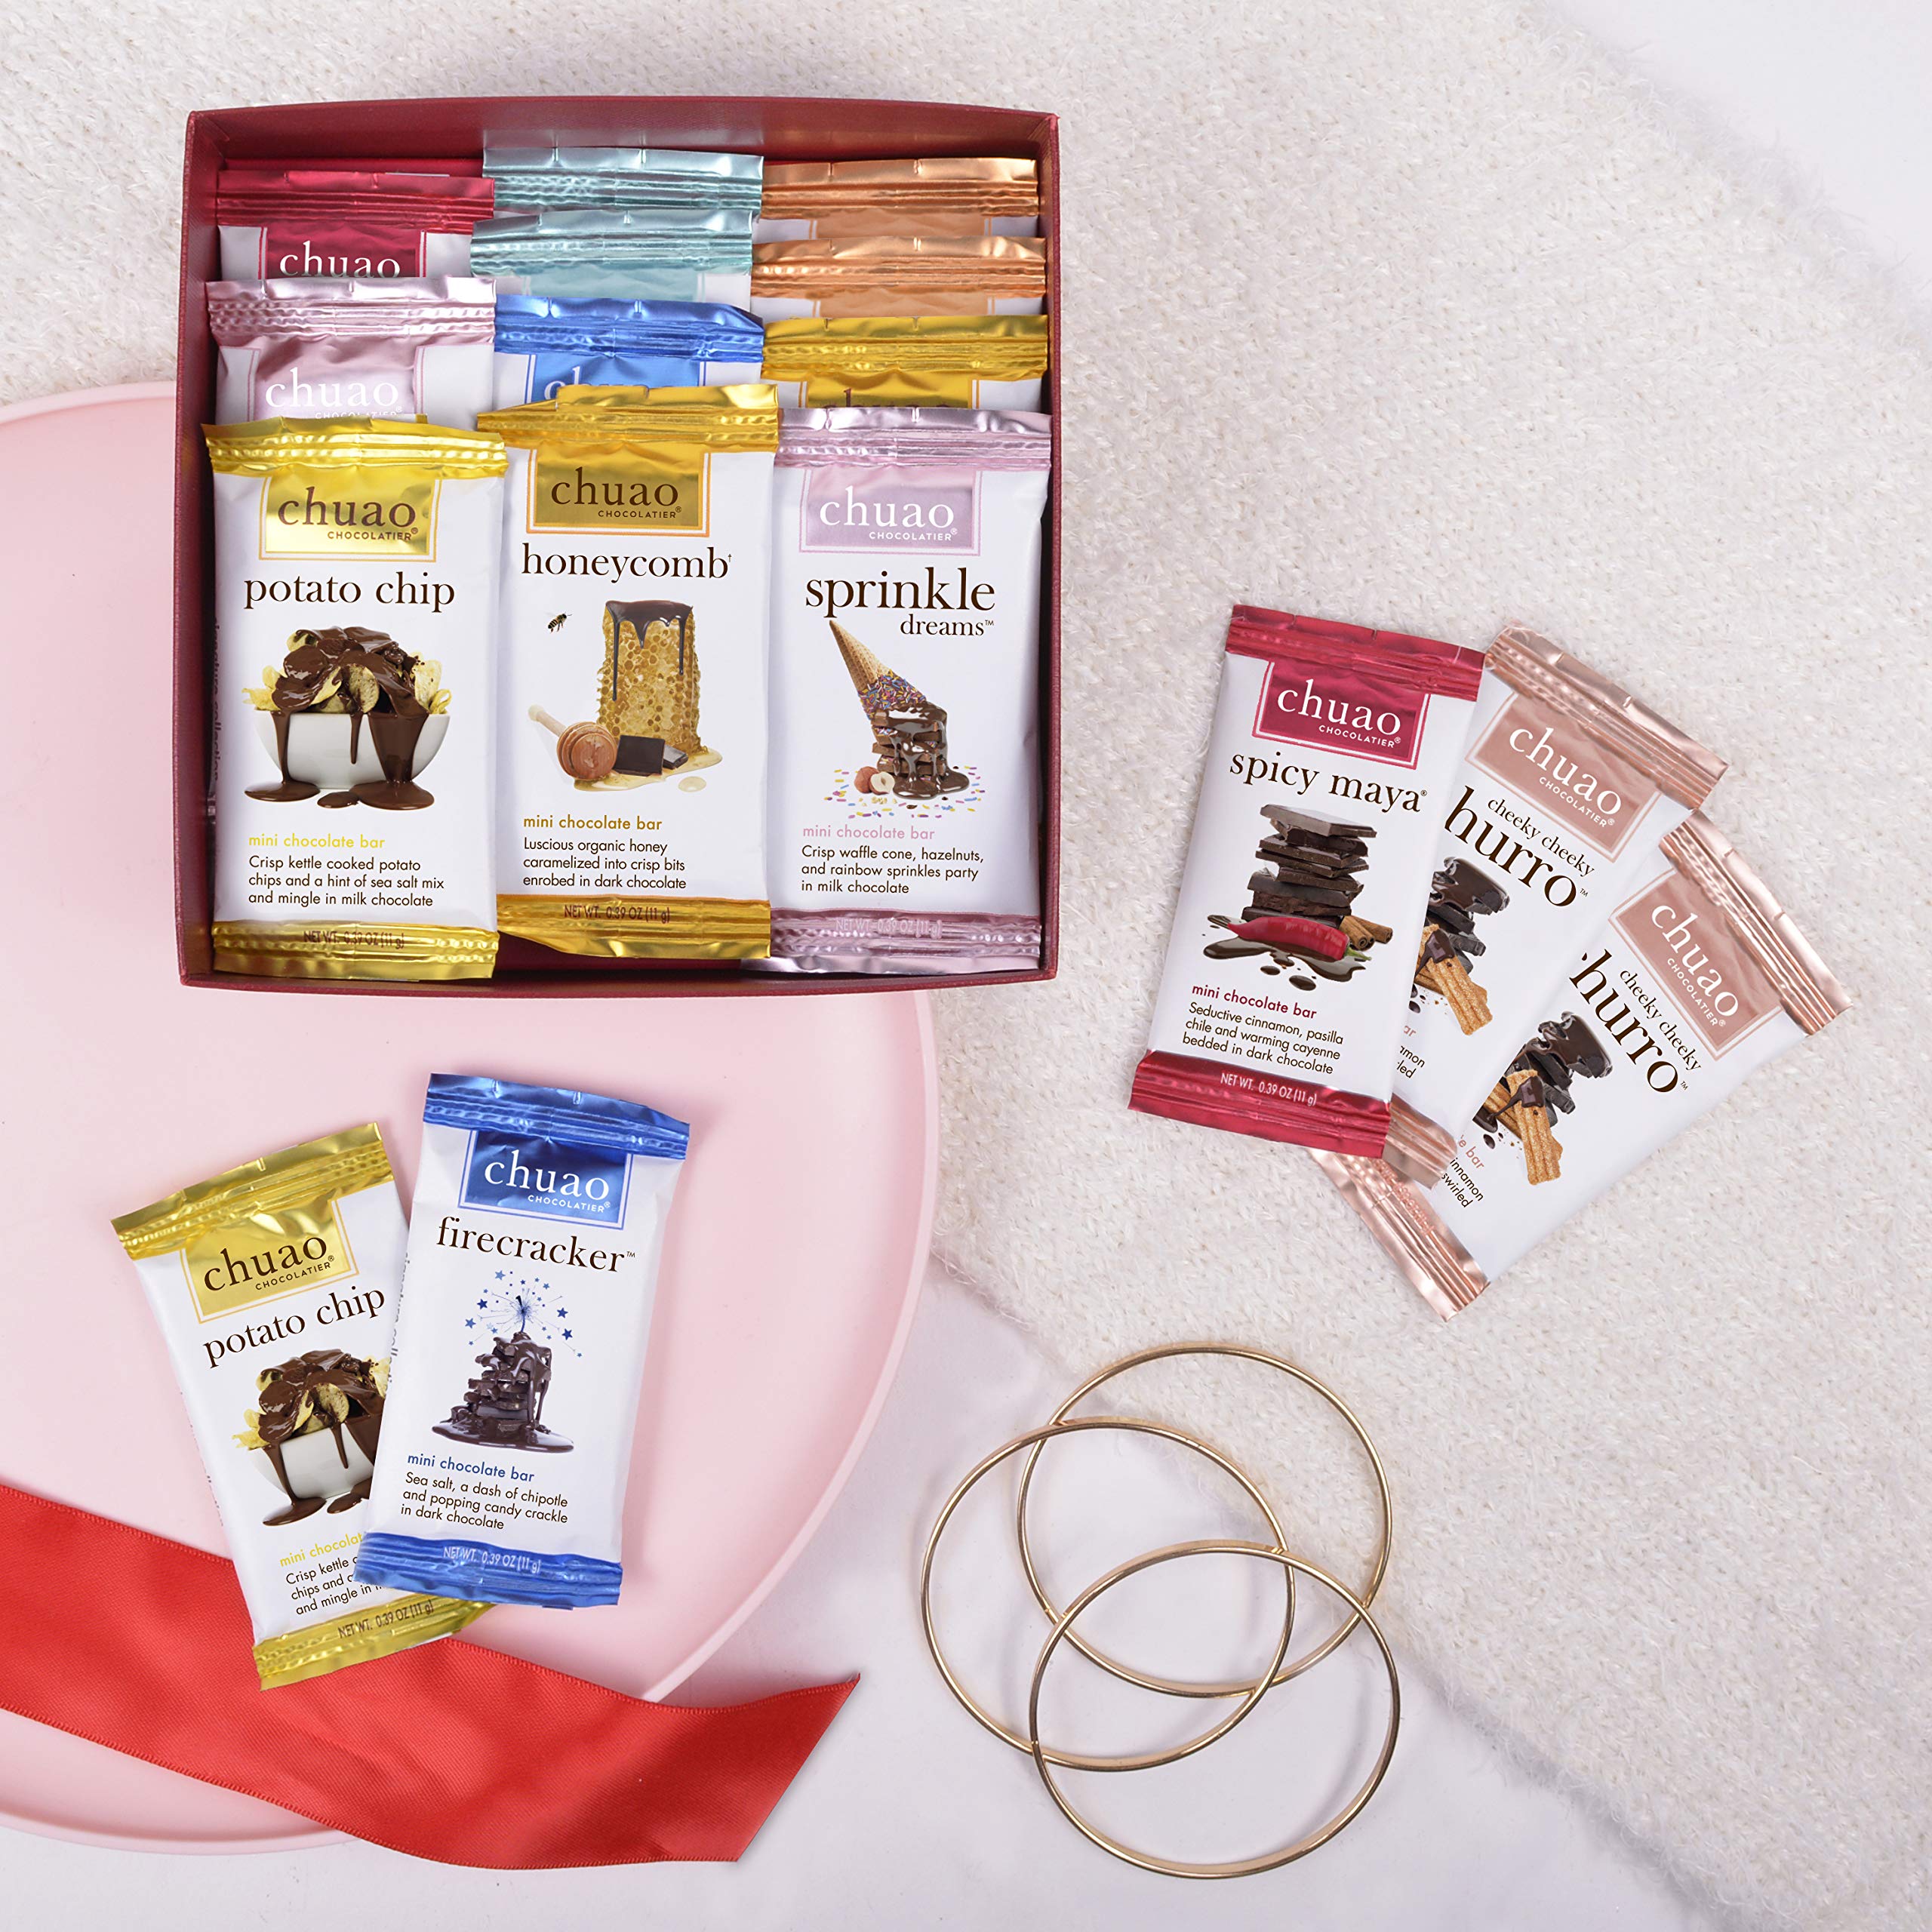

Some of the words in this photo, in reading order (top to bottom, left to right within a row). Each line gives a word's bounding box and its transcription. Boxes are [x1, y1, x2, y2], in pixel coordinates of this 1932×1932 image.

[279, 241, 401, 277] chuao
[266, 367, 398, 408] chuao
[551, 466, 678, 507] chuao
[278, 486, 416, 528] chuao
[820, 486, 954, 528] chuao
[245, 576, 361, 609] potato
[376, 571, 454, 613] chip
[806, 567, 995, 618] sprinkle
[1277, 679, 1401, 735] chuao
[1229, 751, 1319, 795] spicy
[1509, 727, 1622, 816] chuao
[524, 815, 552, 828] mini
[558, 814, 630, 829] chocolate
[637, 815, 662, 830] bar
[803, 825, 830, 837] mini
[837, 824, 904, 838] chocolate
[911, 826, 934, 839] bar
[1487, 795, 1542, 841] cheeky
[1542, 832, 1595, 876] cheeky
[249, 833, 278, 846] mini
[284, 832, 354, 848] chocolate
[360, 834, 385, 848] bar
[525, 837, 574, 851] Luscious
[577, 840, 625, 854] organic
[630, 838, 667, 856] honey
[802, 845, 835, 861] Crisp
[839, 845, 878, 858] waffle
[882, 851, 915, 861] cone,
[922, 847, 983, 863] hazelnuts,
[249, 855, 283, 872] Crisp
[289, 855, 321, 869] kettle
[327, 857, 374, 869] cooked
[380, 860, 420, 873] potato
[249, 872, 281, 889] chips
[286, 873, 309, 886] and
[315, 878, 322, 887] a
[328, 874, 350, 887] hint
[354, 874, 367, 887] of
[371, 879, 392, 888] sea
[397, 875, 418, 888] salt
[423, 878, 444, 888] mix
[523, 872, 574, 886] enrobed
[580, 875, 589, 886] in
[595, 874, 623, 887] dark
[626, 875, 686, 888] chocolate
[524, 855, 599, 869] caramelized
[605, 858, 626, 869] into
[631, 859, 660, 874] crisp
[665, 857, 685, 871] bits
[801, 862, 825, 874] and
[831, 863, 882, 875] rainbow
[888, 864, 940, 879] sprinkles
[946, 868, 978, 881] party
[249, 891, 273, 903] and
[278, 891, 320, 907] mingle
[326, 894, 336, 904] in
[342, 892, 366, 905] milk
[371, 892, 432, 906] chocolate
[802, 880, 812, 891] in
[818, 879, 842, 892] milk
[848, 880, 909, 893] chocolate
[565, 905, 582, 918] NET
[606, 906, 625, 919] 0.39
[629, 907, 642, 919] OZ
[645, 906, 657, 923] (11
[1652, 905, 1738, 1017] chuao
[1192, 985, 1220, 998] mini
[1224, 989, 1288, 1013] chocolate
[1293, 1002, 1317, 1018] bar
[1189, 1002, 1242, 1023] Seductive
[1245, 1016, 1302, 1038] cinnamon,
[1306, 1030, 1343, 1044] pasilla
[1620, 970, 1662, 1020] cheeky
[1660, 1022, 1701, 1072] cheeky
[1183, 1032, 1229, 1051] bedded
[1232, 1044, 1242, 1055] in
[1247, 1046, 1272, 1062] dark
[1277, 1053, 1333, 1074] chocolate
[1186, 1017, 1211, 1032] chile
[1215, 1026, 1238, 1038] and
[1241, 1032, 1290, 1052] warming
[1293, 1044, 1340, 1060] cayenne
[1220, 1072, 1238, 1086] NET
[1258, 1081, 1277, 1094] 0.39
[1279, 1087, 1292, 1099] OZ
[1294, 1089, 1305, 1102] (11
[1466, 1146, 1485, 1170] bar
[485, 1149, 609, 1201] chuao
[1450, 1157, 1484, 1201] innamon
[204, 1236, 328, 1292] chuao
[202, 1314, 306, 1368] potato
[316, 1285, 385, 1327] chip
[408, 1454, 435, 1466] mini
[440, 1457, 505, 1478] chocolate
[511, 1466, 534, 1481] bar
[405, 1472, 428, 1485] Sea
[432, 1477, 455, 1492] salt,
[473, 1481, 500, 1497] dash
[506, 1487, 518, 1499] of
[521, 1490, 568, 1507] chipotle
[401, 1504, 411, 1515] in
[416, 1505, 442, 1520] dark
[447, 1510, 503, 1529] chocolate
[402, 1490, 426, 1506] and
[430, 1496, 480, 1512] popping
[485, 1503, 521, 1519] candy
[525, 1509, 568, 1523] crackle
[280, 1549, 306, 1567] mini
[310, 1533, 362, 1557] chocolat
[444, 1547, 460, 1558] NET
[481, 1552, 500, 1564] 0.39
[503, 1555, 515, 1567] OZ
[517, 1556, 529, 1571] (11
[286, 1570, 316, 1585] Crisp
[318, 1557, 349, 1574] kettle
[291, 1586, 320, 1600] chips
[324, 1574, 343, 1590] and
[296, 1598, 318, 1615] and
[321, 1587, 358, 1608] mingle
[362, 1585, 371, 1595] in
[338, 1625, 355, 1638] NET
[375, 1614, 394, 1628] 0.39
[395, 1607, 410, 1620] OZ
[410, 1602, 423, 1617] (11
